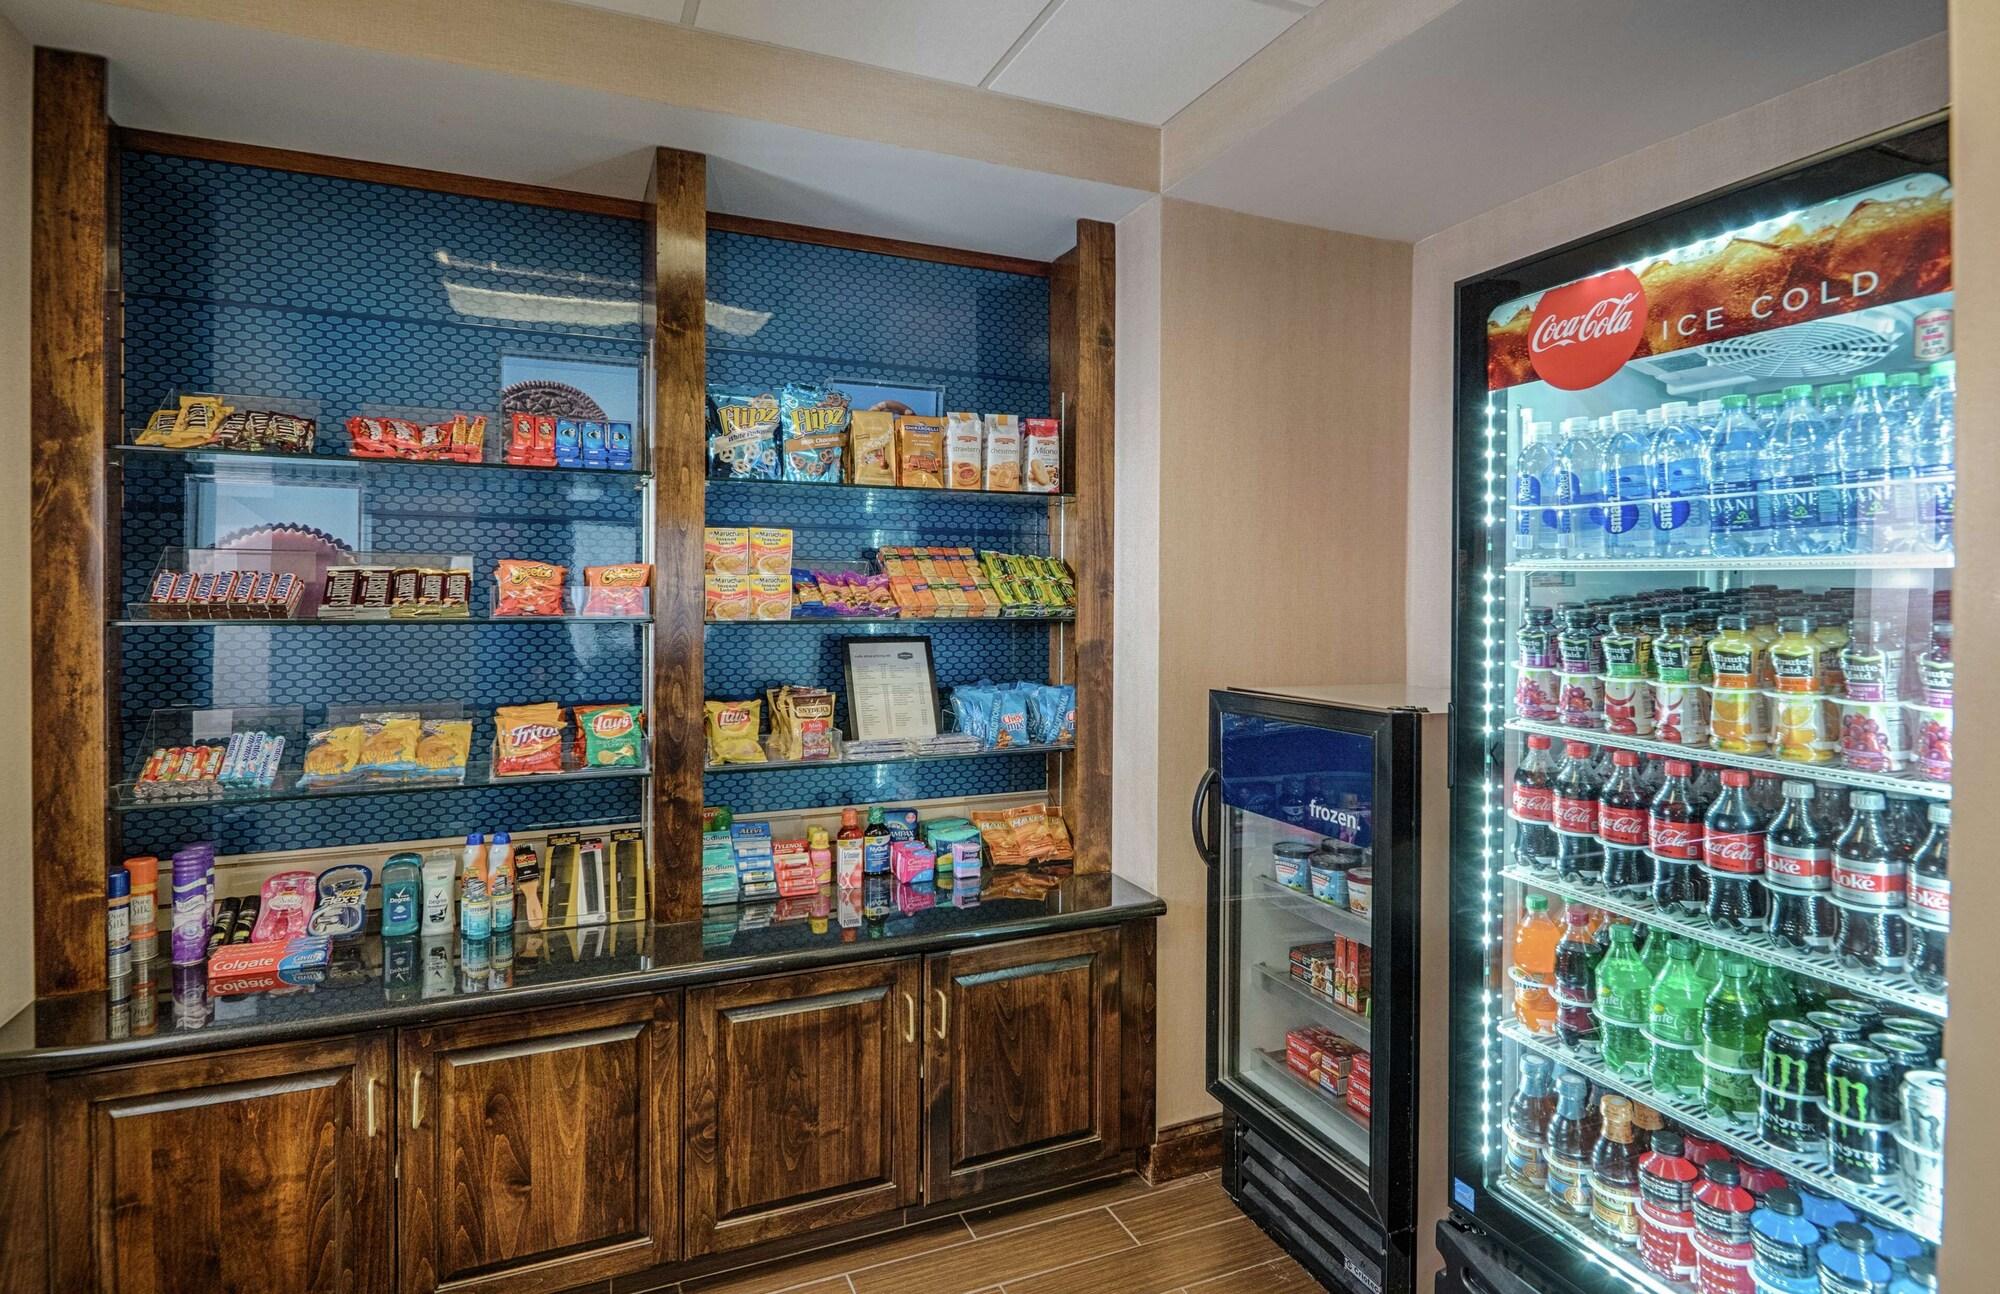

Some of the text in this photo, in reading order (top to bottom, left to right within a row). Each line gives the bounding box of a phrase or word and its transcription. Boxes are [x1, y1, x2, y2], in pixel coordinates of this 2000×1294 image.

[1663, 271, 1880, 341] ICE COLD
[1532, 291, 1639, 354] Coca-Cola
[718, 406, 781, 436] Flipz
[790, 407, 846, 433] Flipz
[1050, 695, 1070, 740] TRADITIONAL
[511, 723, 560, 746] Fritos
[1309, 798, 1361, 831] frozen.
[1831, 870, 1876, 890] Coke
[320, 896, 359, 905] Flex 3
[213, 957, 274, 972] Colgate
